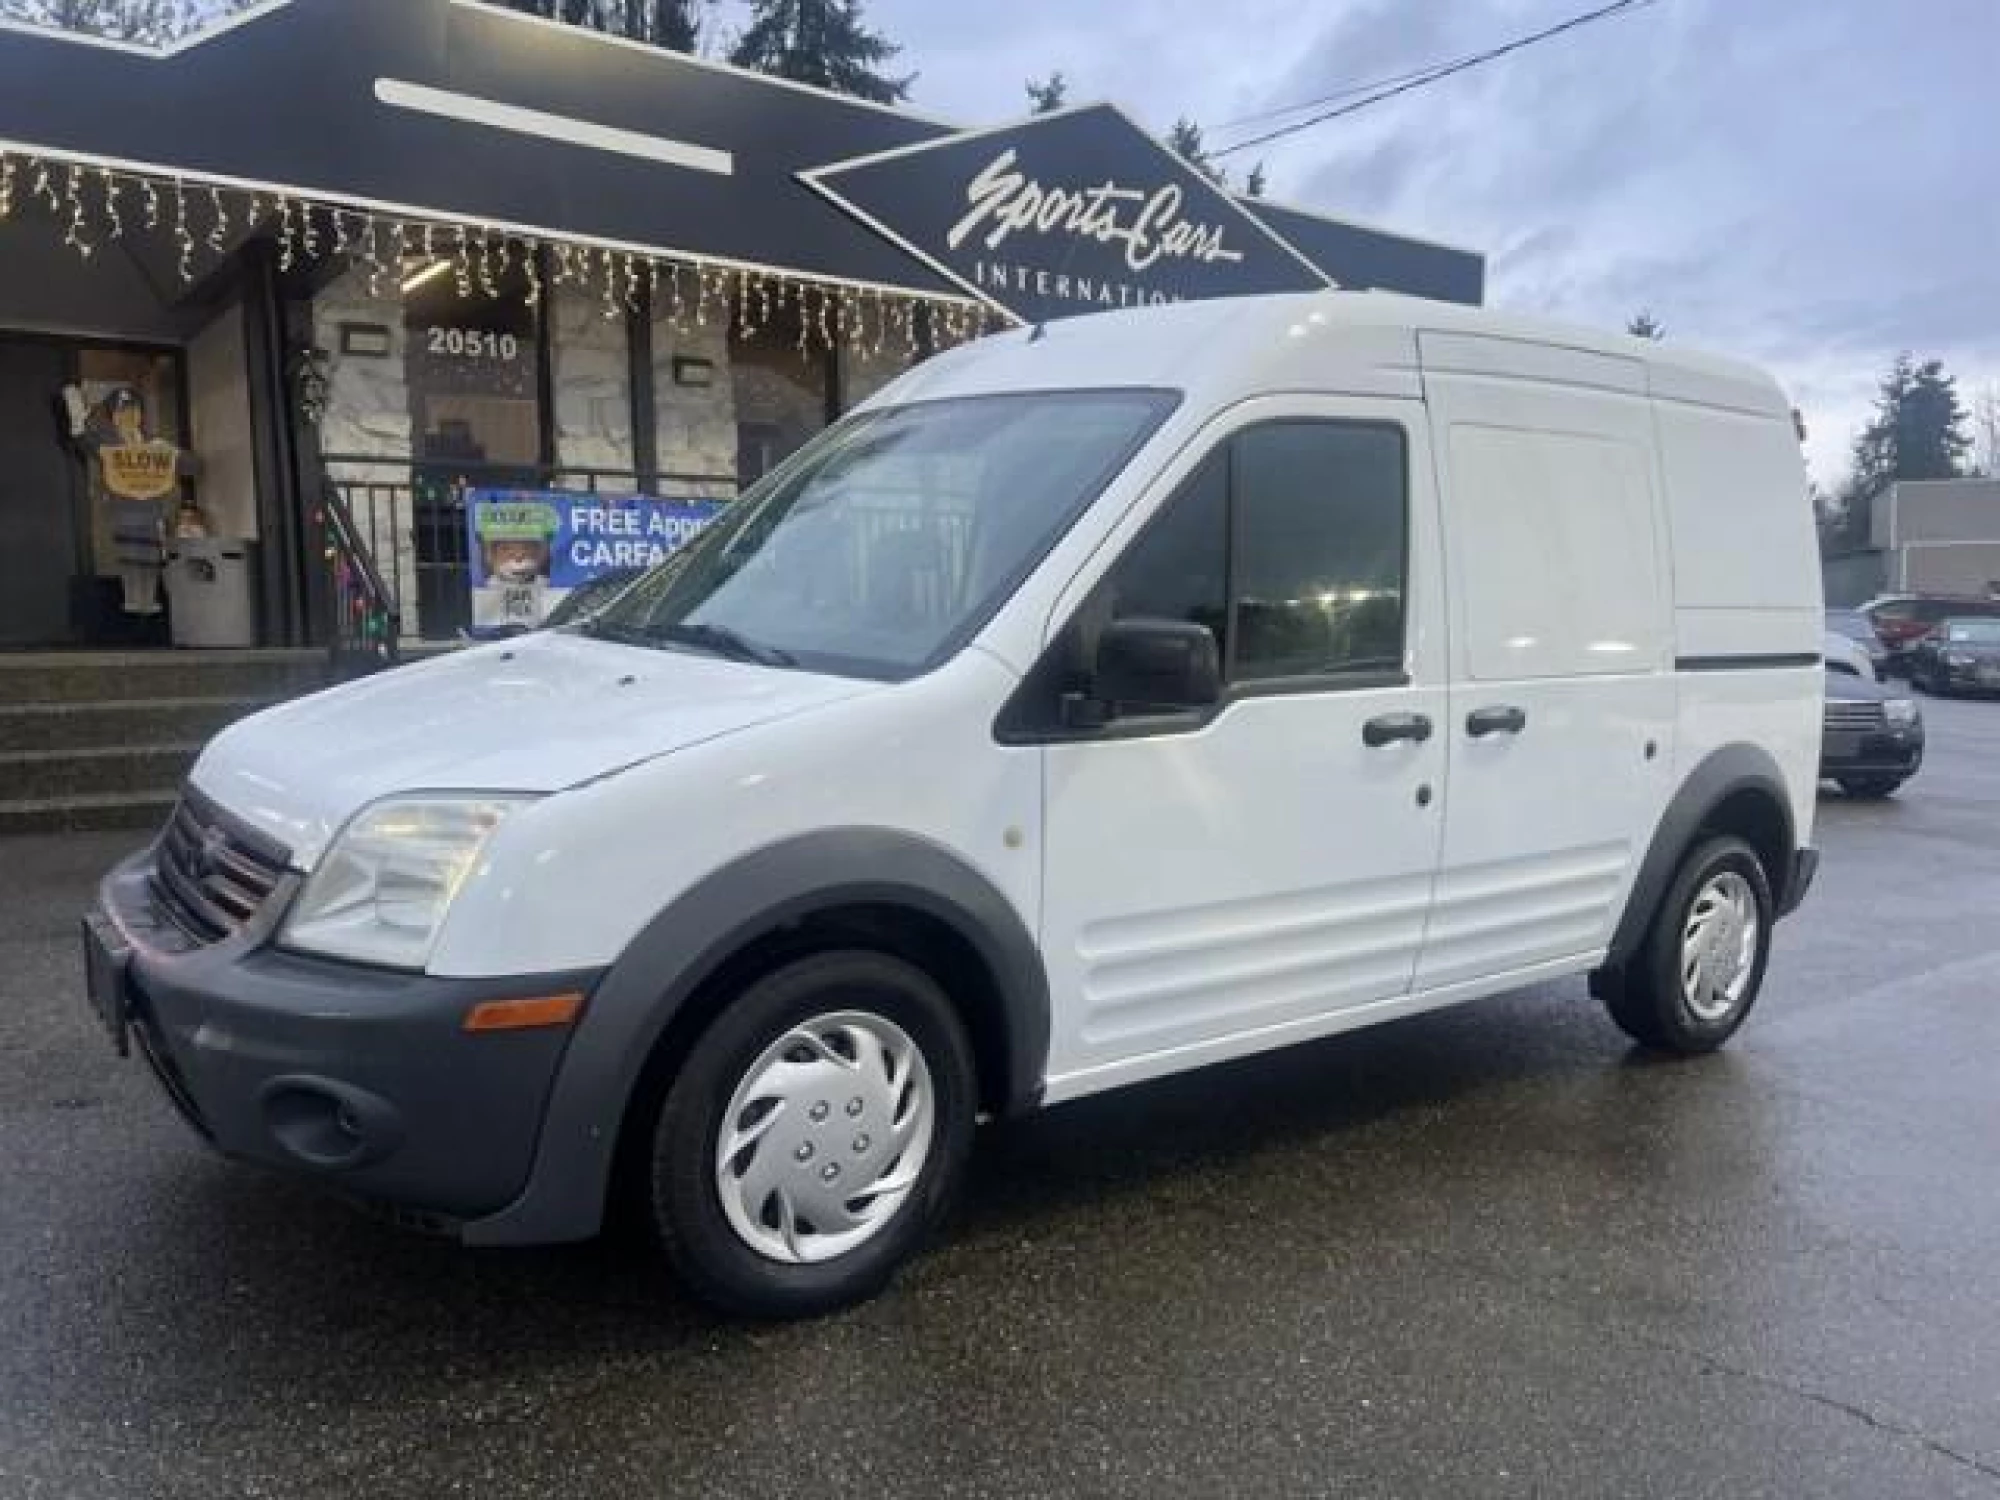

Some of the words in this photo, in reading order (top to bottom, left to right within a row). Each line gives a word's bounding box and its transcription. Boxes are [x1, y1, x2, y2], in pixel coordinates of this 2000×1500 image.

[947, 149, 1144, 250] Sports
[1125, 183, 1243, 272] Cars
[975, 261, 1185, 307] INTERNATIO
[427, 325, 517, 360] 20510
[112, 449, 172, 470] SLOW
[571, 507, 641, 535] FREE
[571, 540, 677, 567] CARFA
